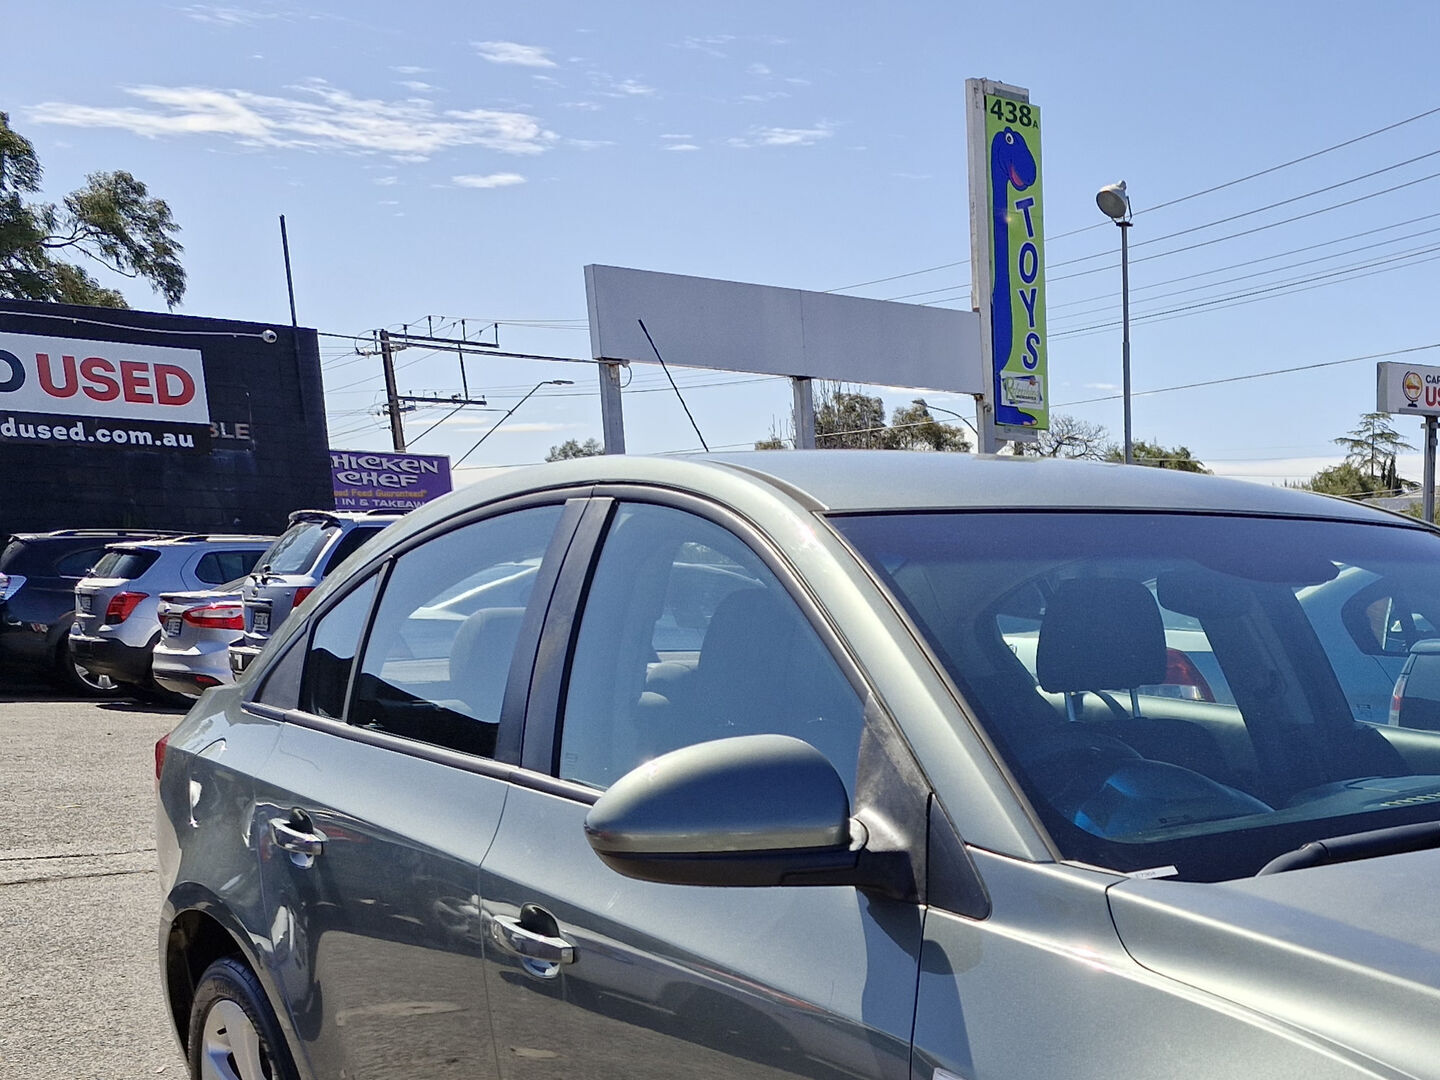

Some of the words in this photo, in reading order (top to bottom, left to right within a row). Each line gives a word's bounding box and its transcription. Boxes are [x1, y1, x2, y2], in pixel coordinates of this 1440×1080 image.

[1015, 196, 1041, 370] TOYS
[36, 353, 196, 406] USED
[330, 453, 439, 474] HICKEN
[336, 470, 418, 488] CHEF
